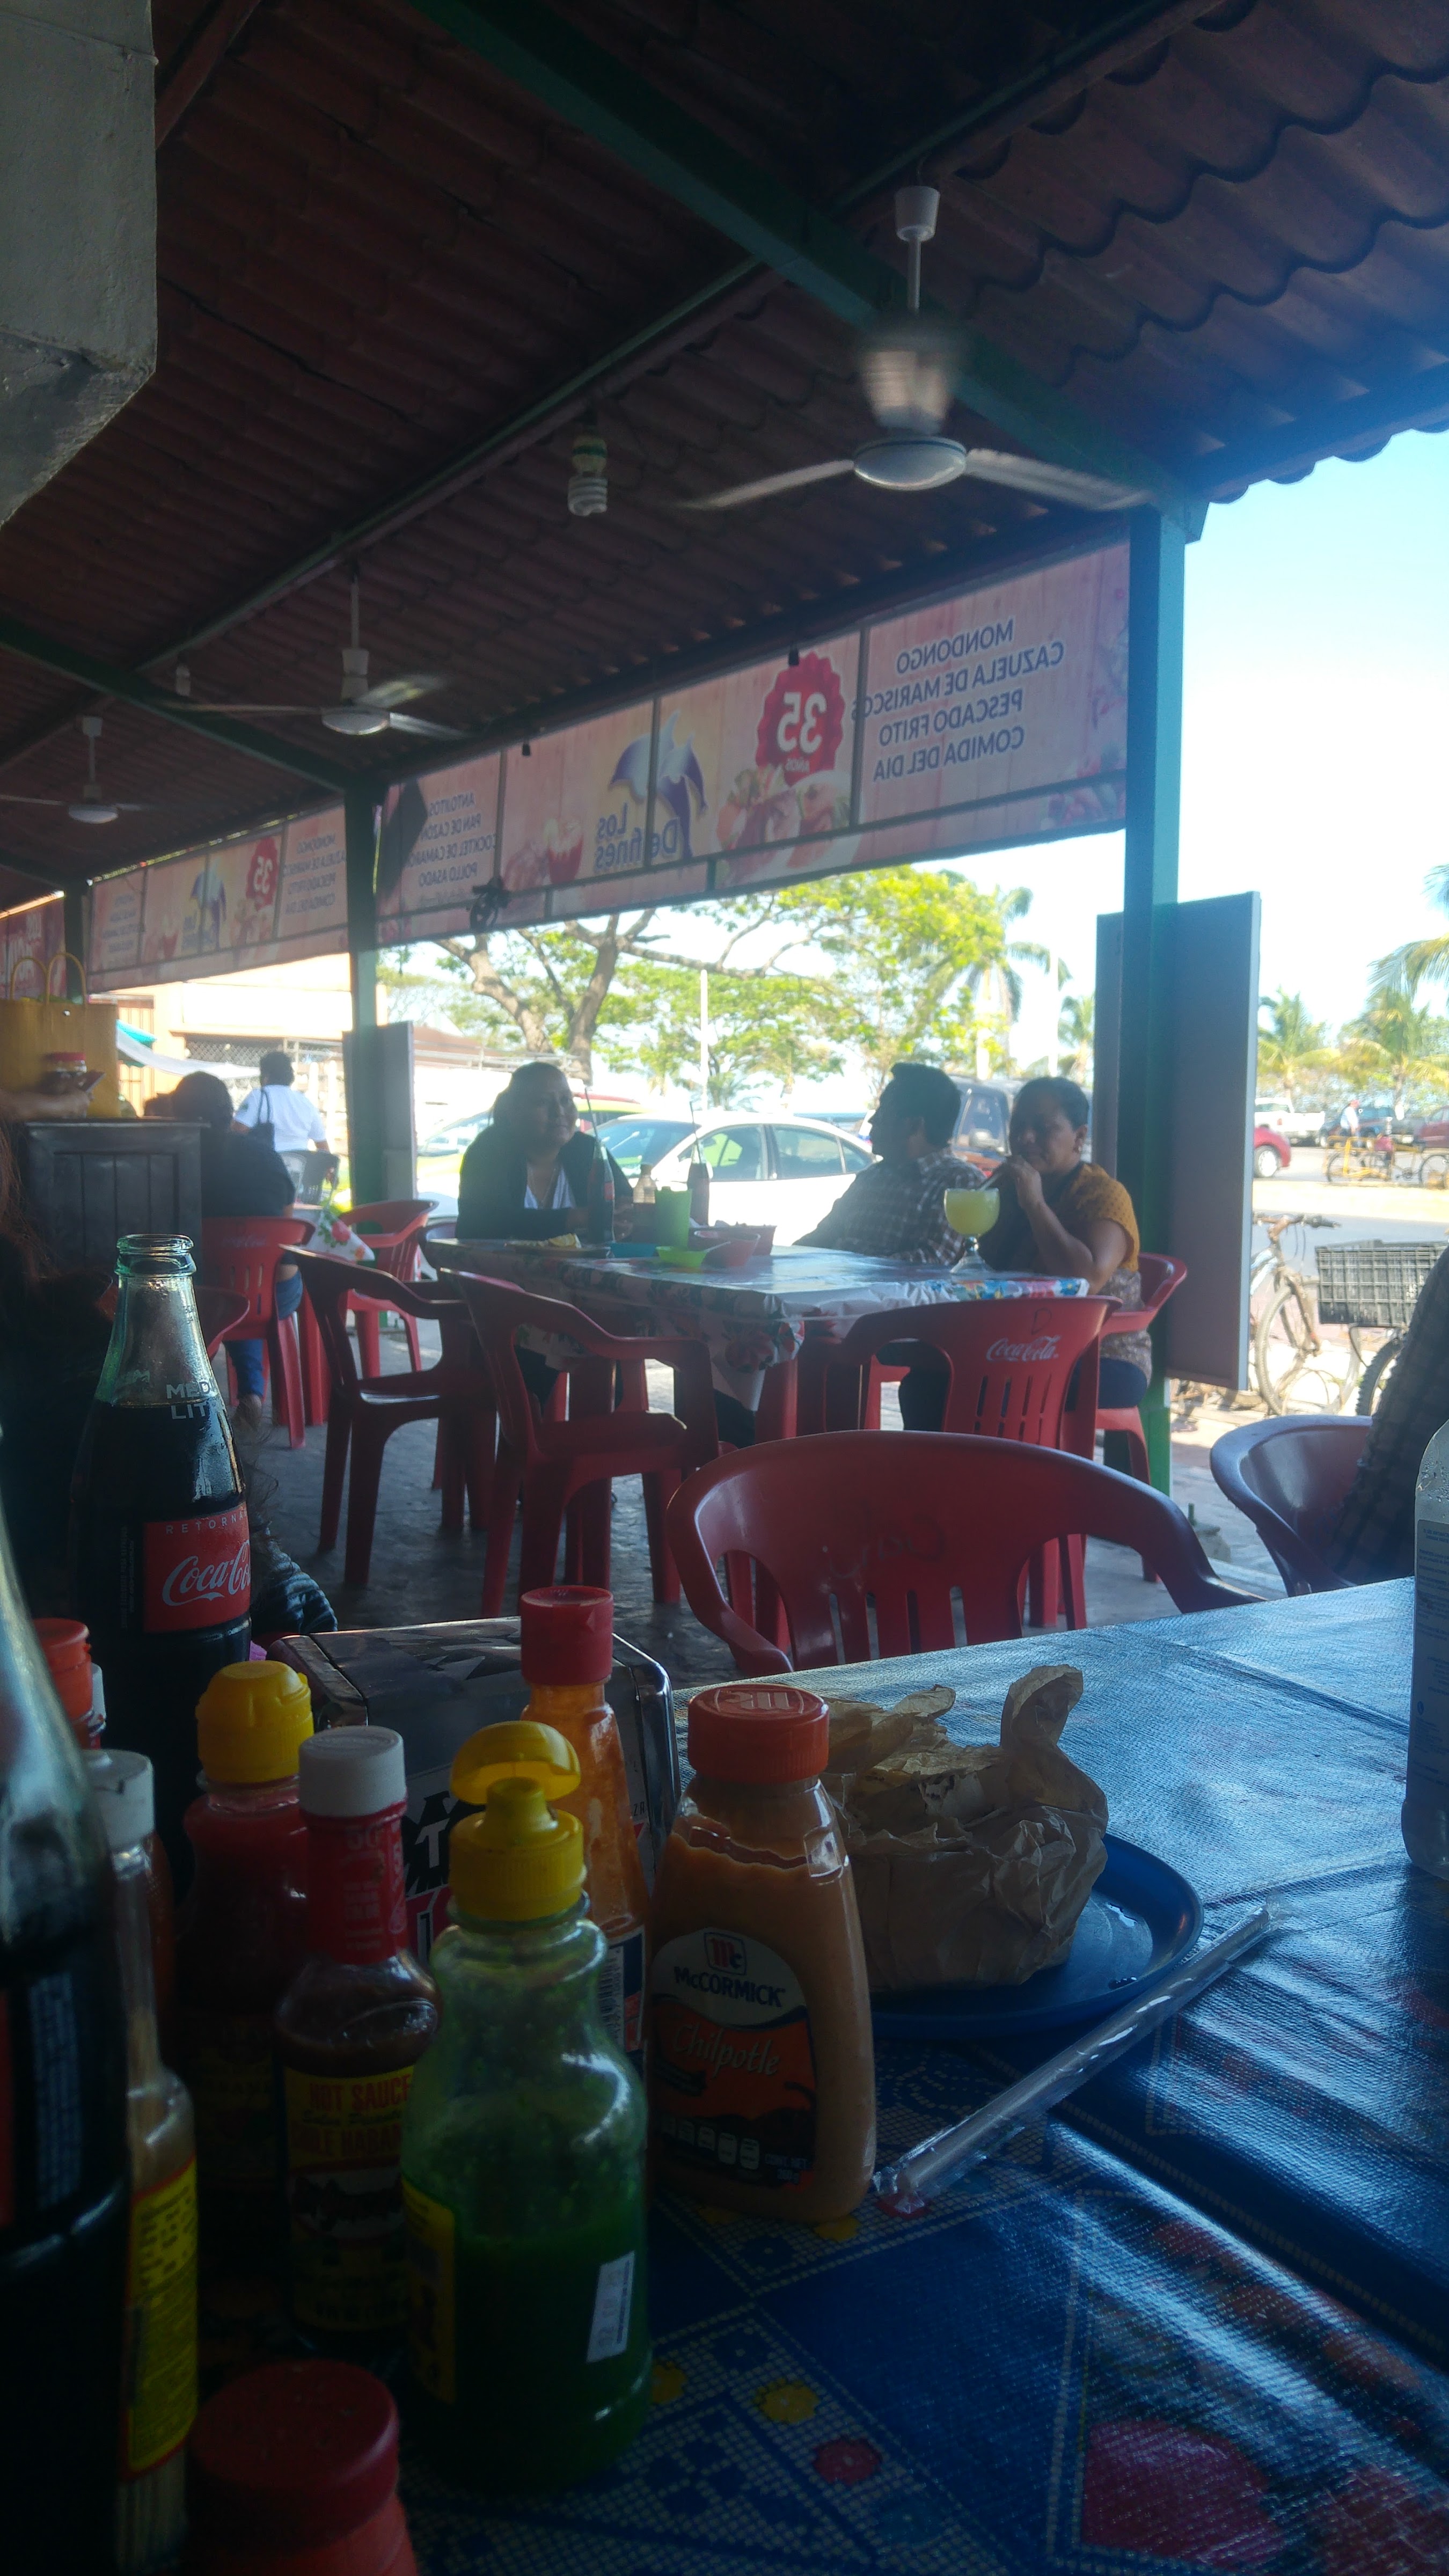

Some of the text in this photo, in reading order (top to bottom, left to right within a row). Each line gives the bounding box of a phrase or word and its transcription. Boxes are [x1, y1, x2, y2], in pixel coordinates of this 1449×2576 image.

[171, 1403, 207, 1419] LIT
[162, 1539, 251, 1607] Coca-Co
[674, 1966, 786, 2008] McCORMICK
[672, 2022, 780, 2082] Chipotle
